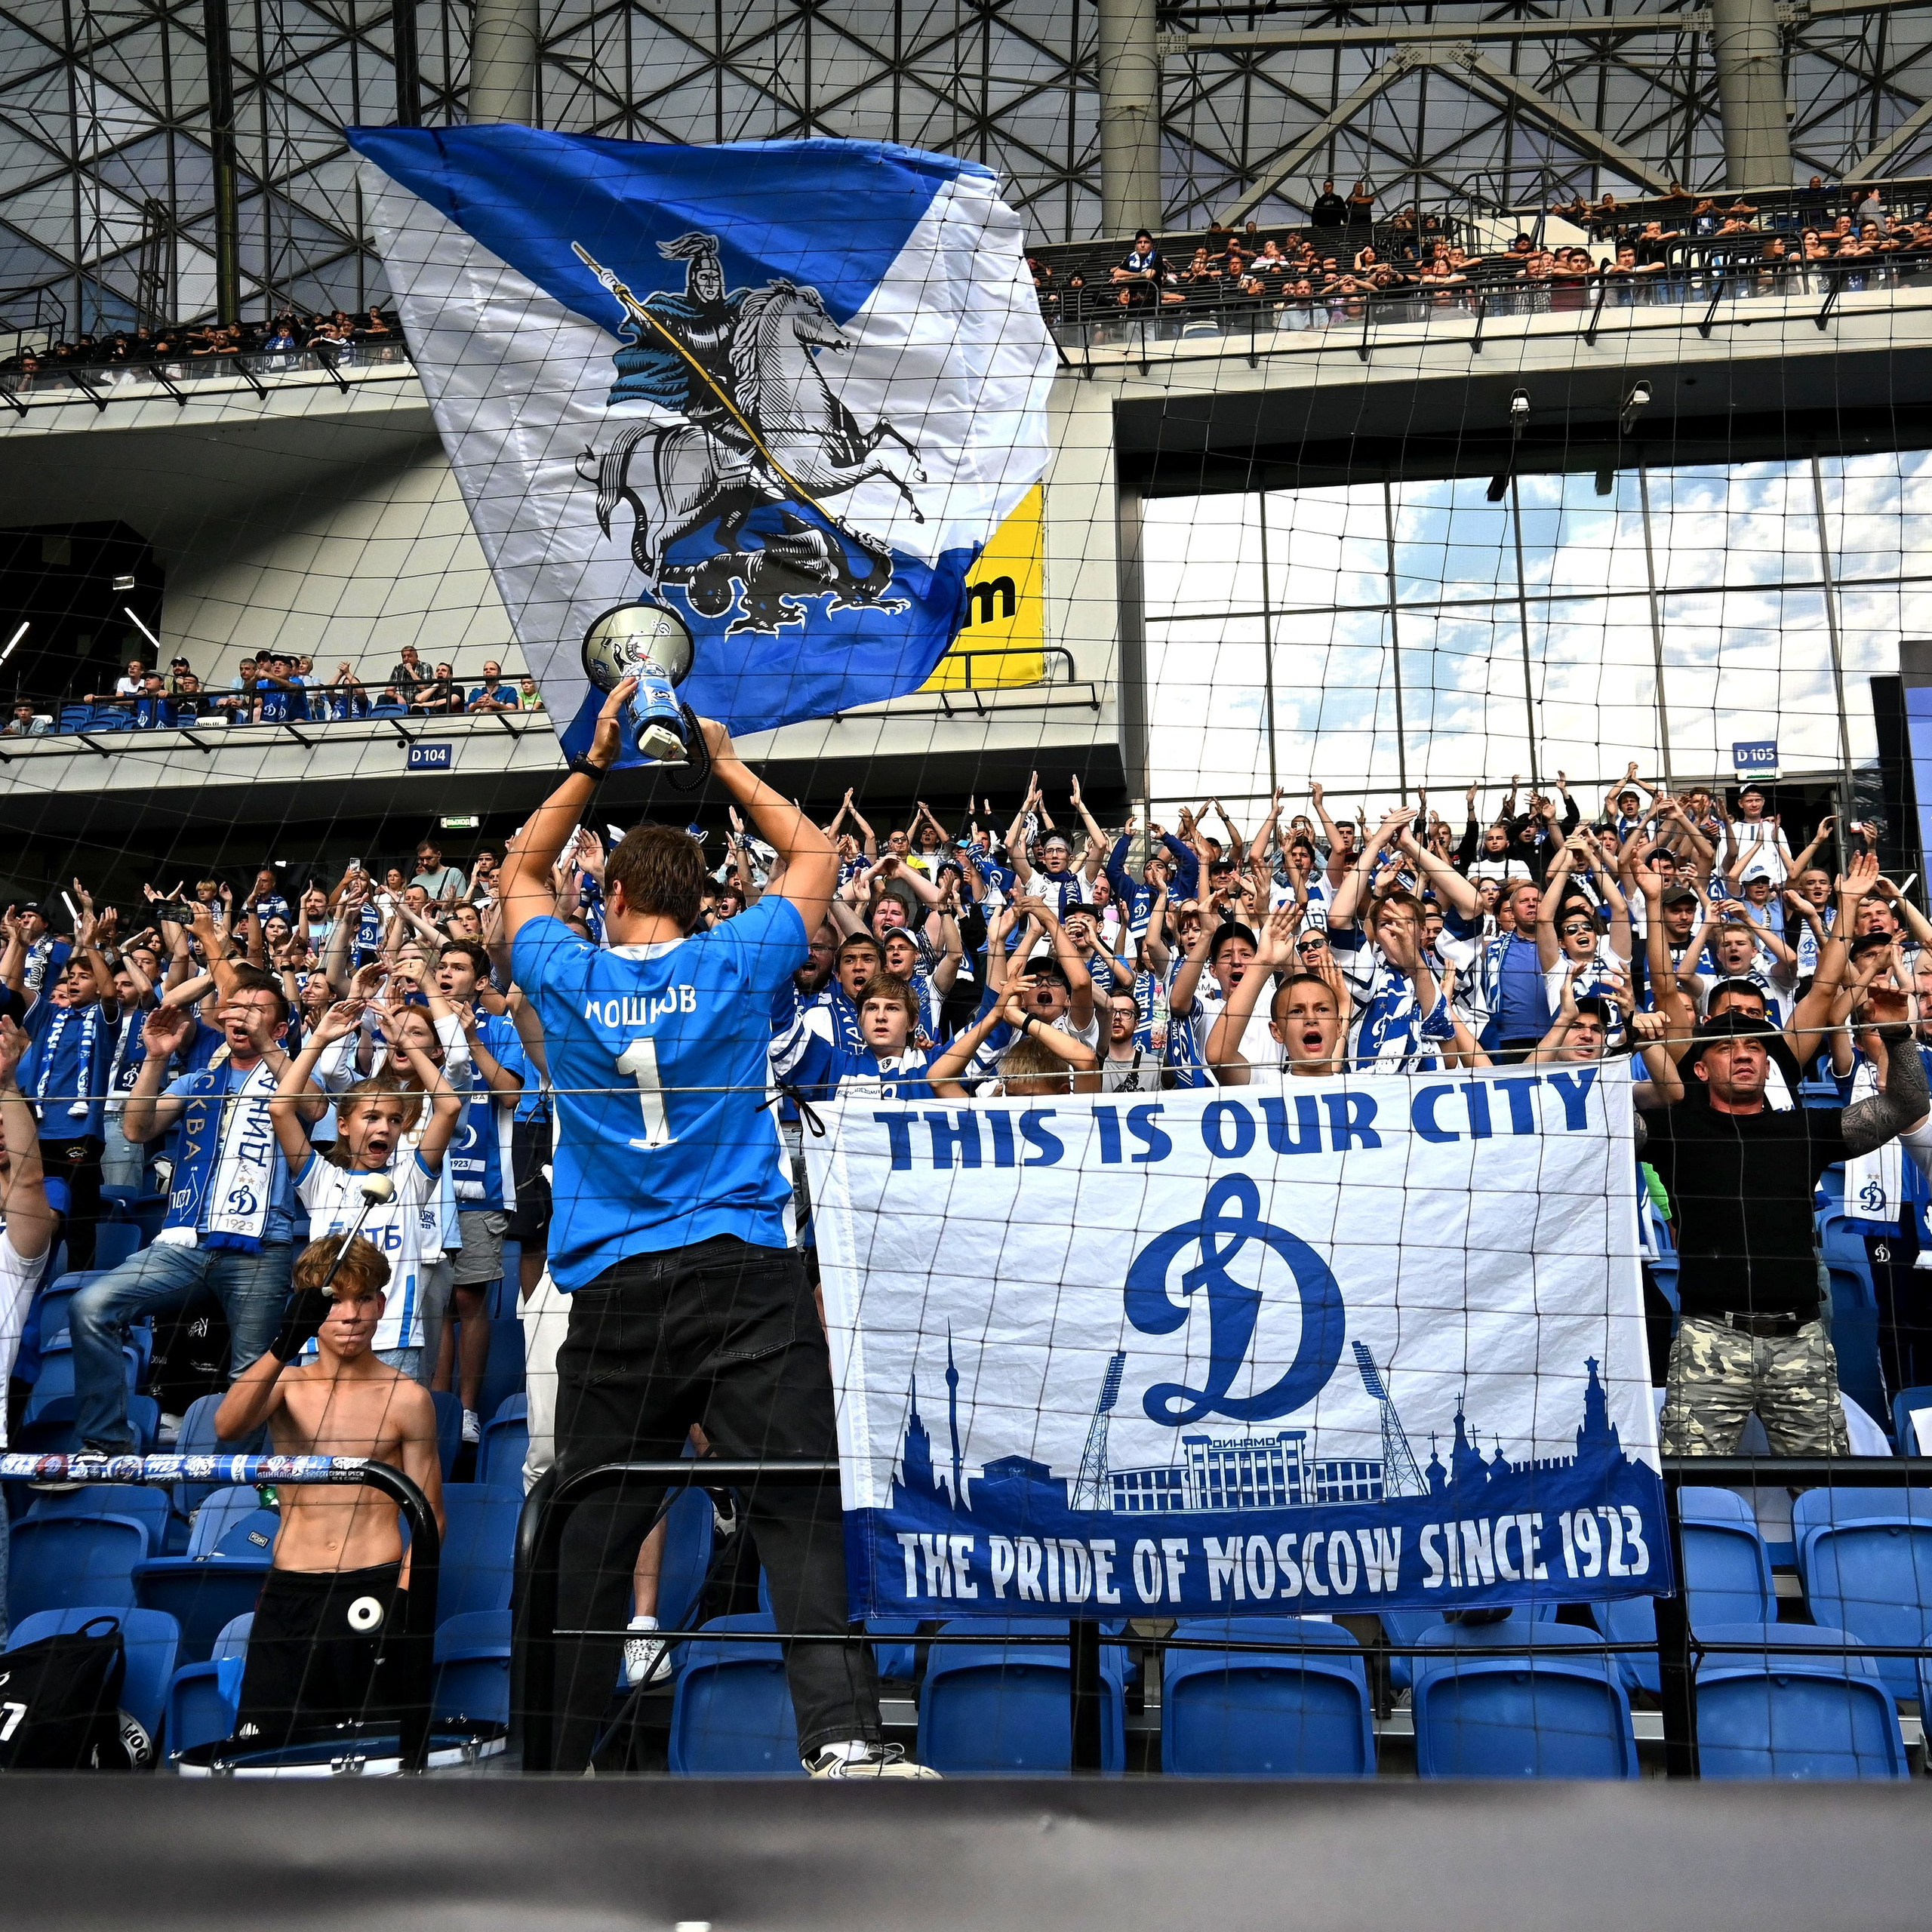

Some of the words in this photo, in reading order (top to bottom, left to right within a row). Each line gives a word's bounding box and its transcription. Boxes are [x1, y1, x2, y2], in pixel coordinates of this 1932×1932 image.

[411, 749, 422, 762] D
[423, 749, 446, 762] 104
[1737, 749, 1748, 762] D
[1751, 747, 1774, 761] 105
[446, 818, 471, 826] ВЫХОД
[615, 1036, 679, 1150] 1
[874, 1108, 1065, 1171] THIS
[1092, 1103, 1174, 1164] IS
[1201, 1091, 1382, 1158] OUR
[1411, 1068, 1598, 1144] CITY
[225, 1218, 254, 1232] 1923
[1212, 1436, 1276, 1449] ДИНАМО
[897, 1532, 978, 1600] THE
[989, 1534, 1121, 1604] PRIDE
[1132, 1537, 1190, 1604] OF
[1200, 1527, 1403, 1603] MOSCOW
[1421, 1515, 1549, 1589] SINCE
[1557, 1506, 1650, 1579] 1923
